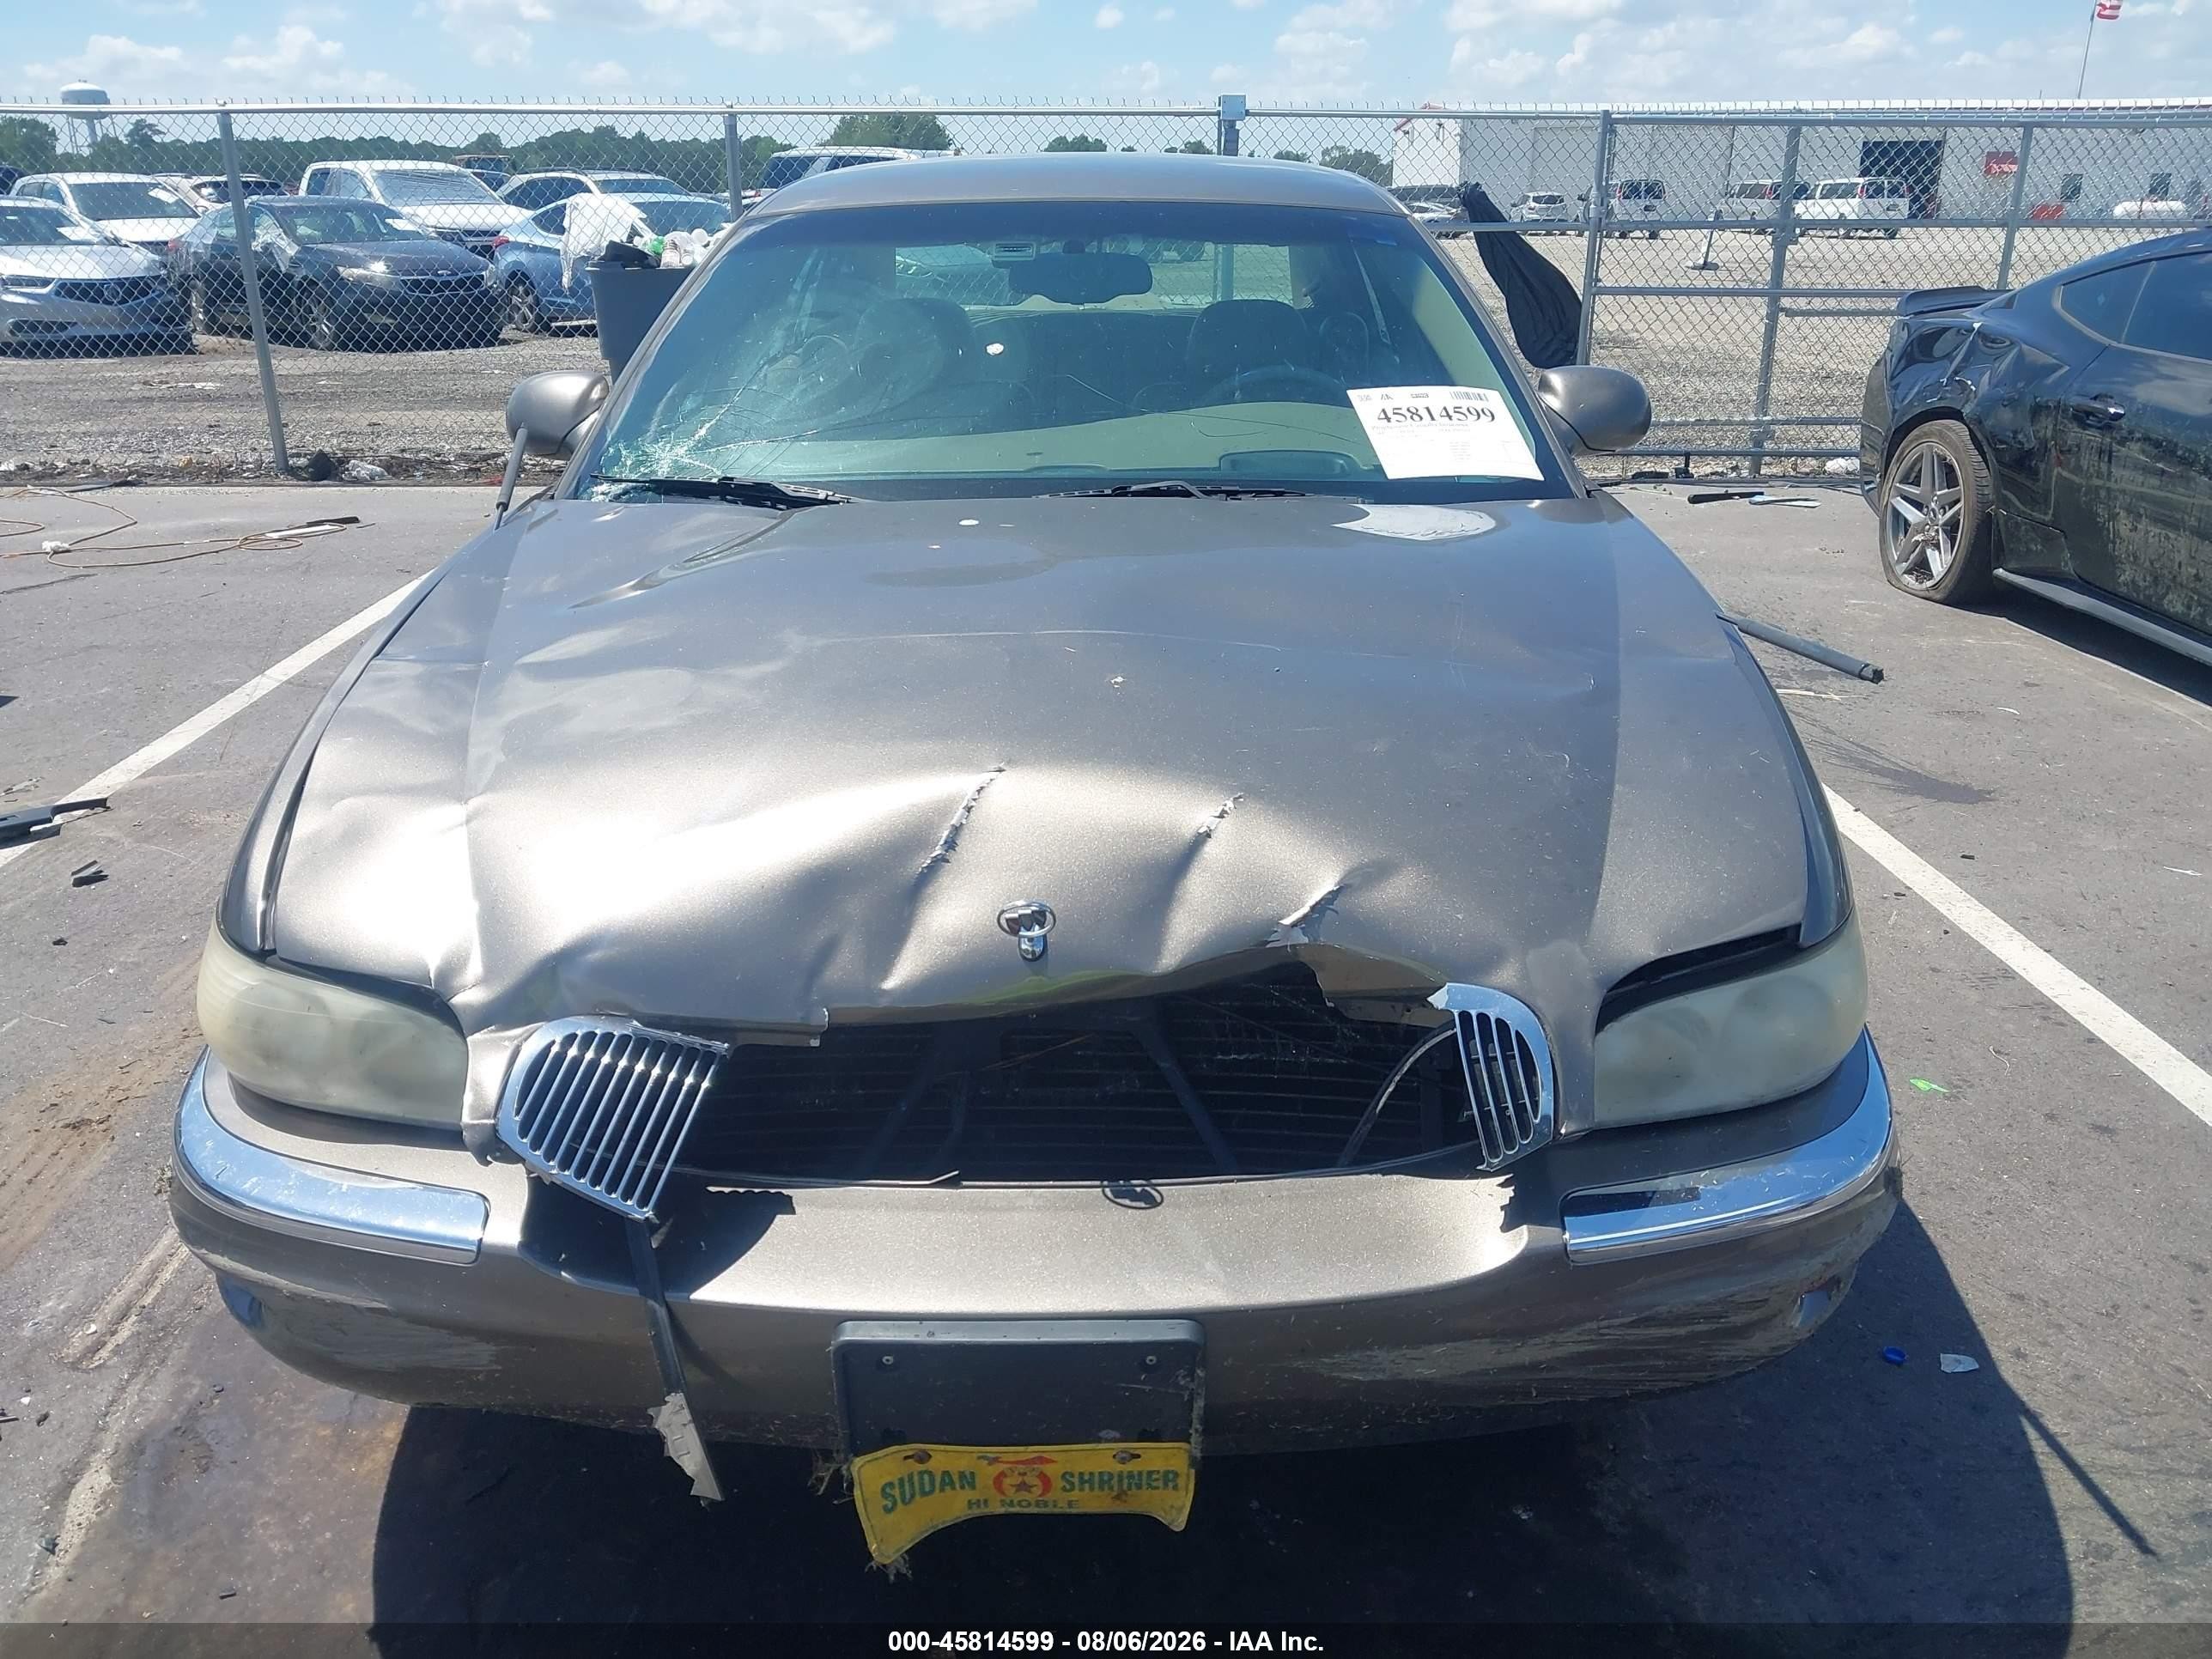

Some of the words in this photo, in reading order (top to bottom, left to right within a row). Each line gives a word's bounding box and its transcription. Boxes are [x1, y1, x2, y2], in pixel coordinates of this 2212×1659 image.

[1377, 405, 1496, 423] 45814599
[880, 1469, 977, 1515] SUDAN
[1060, 1469, 1180, 1493] SHRINER
[967, 1499, 989, 1510] HI
[1000, 1498, 1080, 1510] NOBLE
